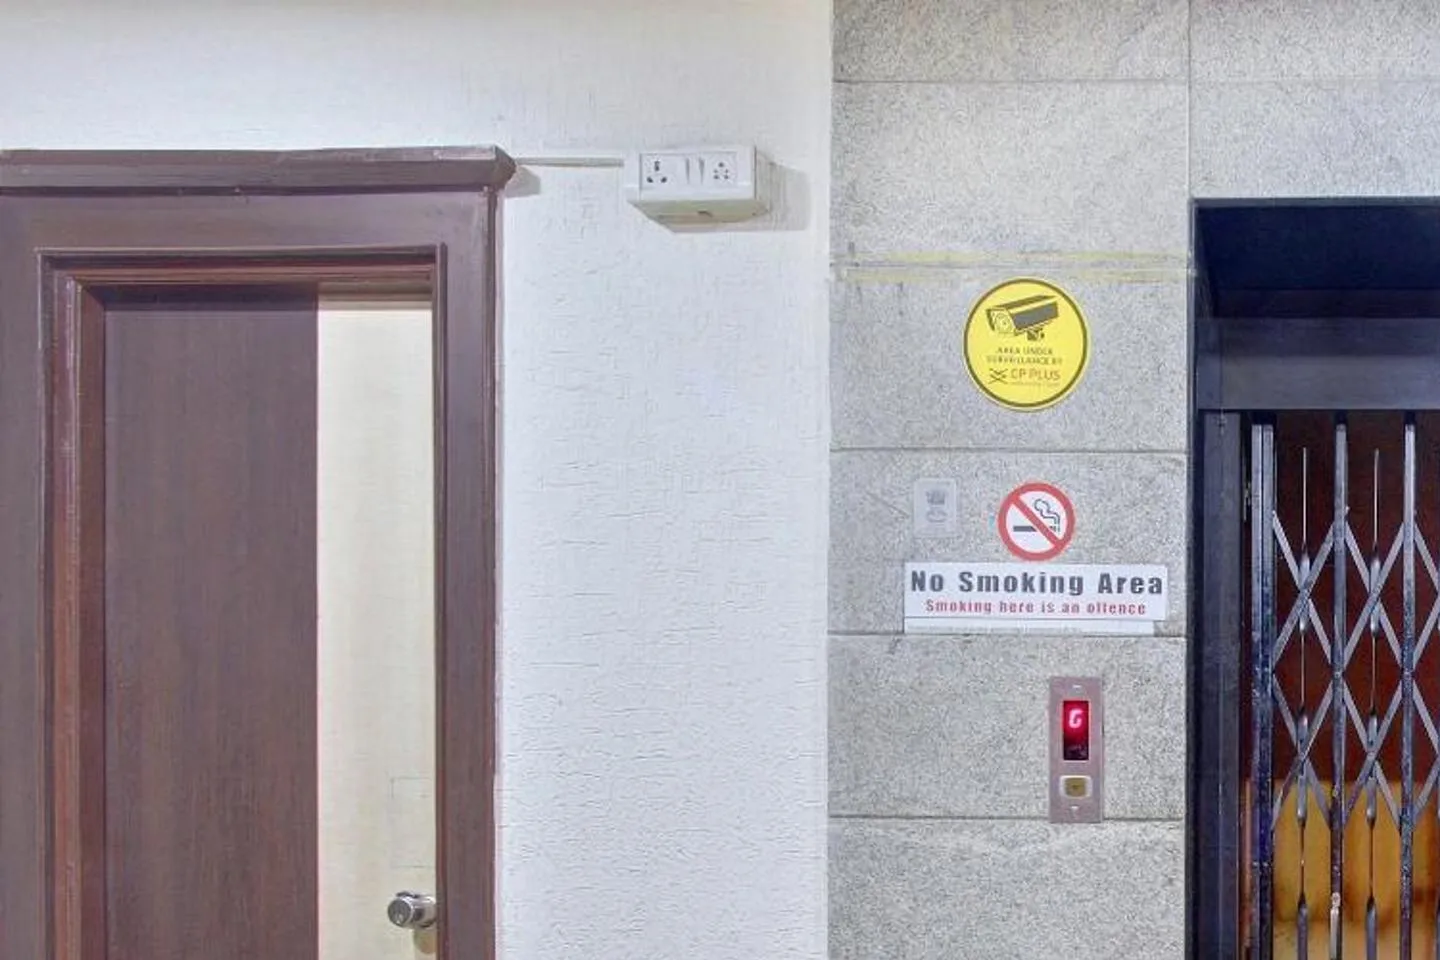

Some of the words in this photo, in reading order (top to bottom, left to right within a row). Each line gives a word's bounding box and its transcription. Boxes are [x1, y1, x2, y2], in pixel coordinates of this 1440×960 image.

[1010, 367, 1026, 379] CP
[1029, 368, 1061, 381] PLUS
[911, 569, 944, 593] No
[958, 570, 1084, 597] Smoking
[1097, 572, 1162, 595] Area
[925, 598, 992, 614] Smoking
[999, 600, 1034, 613] here
[1041, 601, 1055, 613] is
[1061, 602, 1080, 614] an
